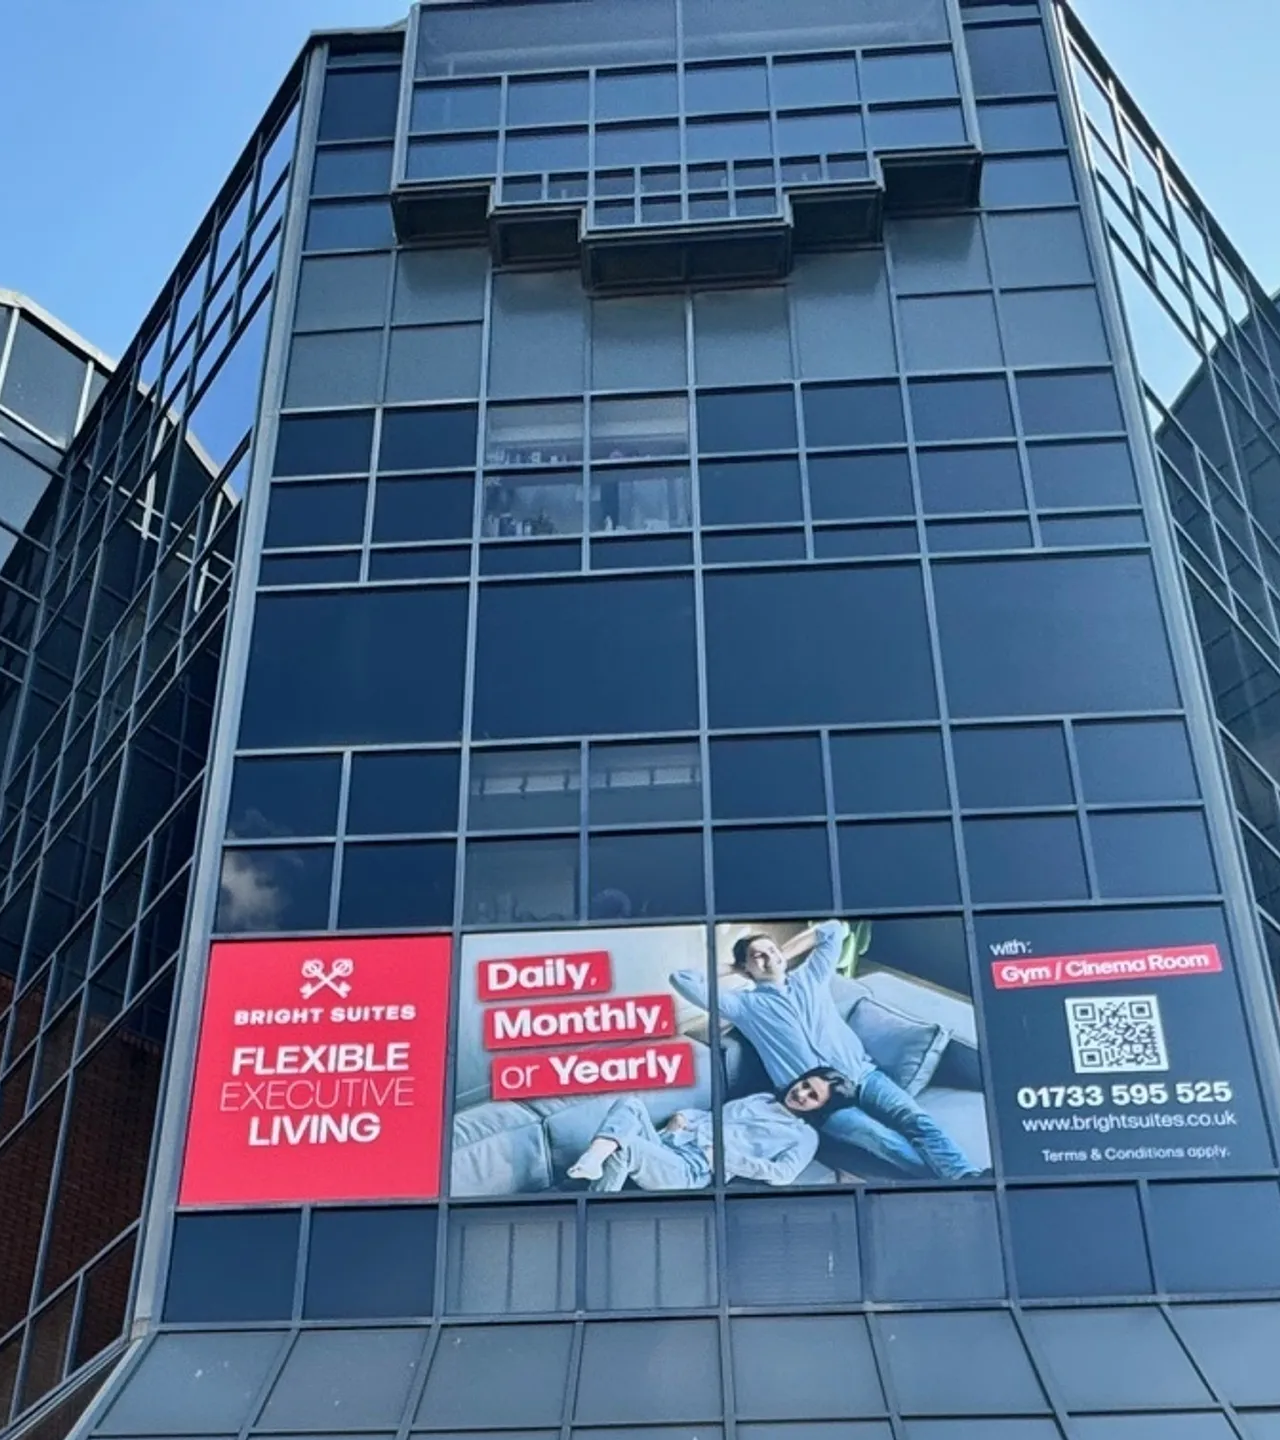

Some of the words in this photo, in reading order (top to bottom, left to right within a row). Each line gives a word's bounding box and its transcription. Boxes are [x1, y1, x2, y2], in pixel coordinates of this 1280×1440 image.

[990, 940, 1032, 956] with:
[487, 958, 597, 992] Daily,
[1001, 966, 1051, 984] Gym
[1066, 957, 1146, 978] Cinema
[1148, 954, 1209, 972] Room
[234, 1008, 324, 1026] BRIGHT
[331, 1005, 415, 1022] SUITES
[493, 1001, 668, 1039] Monthly,
[233, 1043, 410, 1076] FLEXIBLE
[500, 1064, 539, 1090] or
[549, 1051, 682, 1087] Yearly
[220, 1077, 415, 1112] EXECUTIVE
[1017, 1086, 1104, 1109] 01733
[1111, 1084, 1169, 1105] 595
[1176, 1081, 1233, 1103] 525
[248, 1112, 381, 1145] LIVING
[1022, 1111, 1237, 1133] www.brightsuites.co.uk
[1042, 1149, 1088, 1163] Terms
[1090, 1148, 1102, 1161] &
[1104, 1147, 1183, 1161] Conditions
